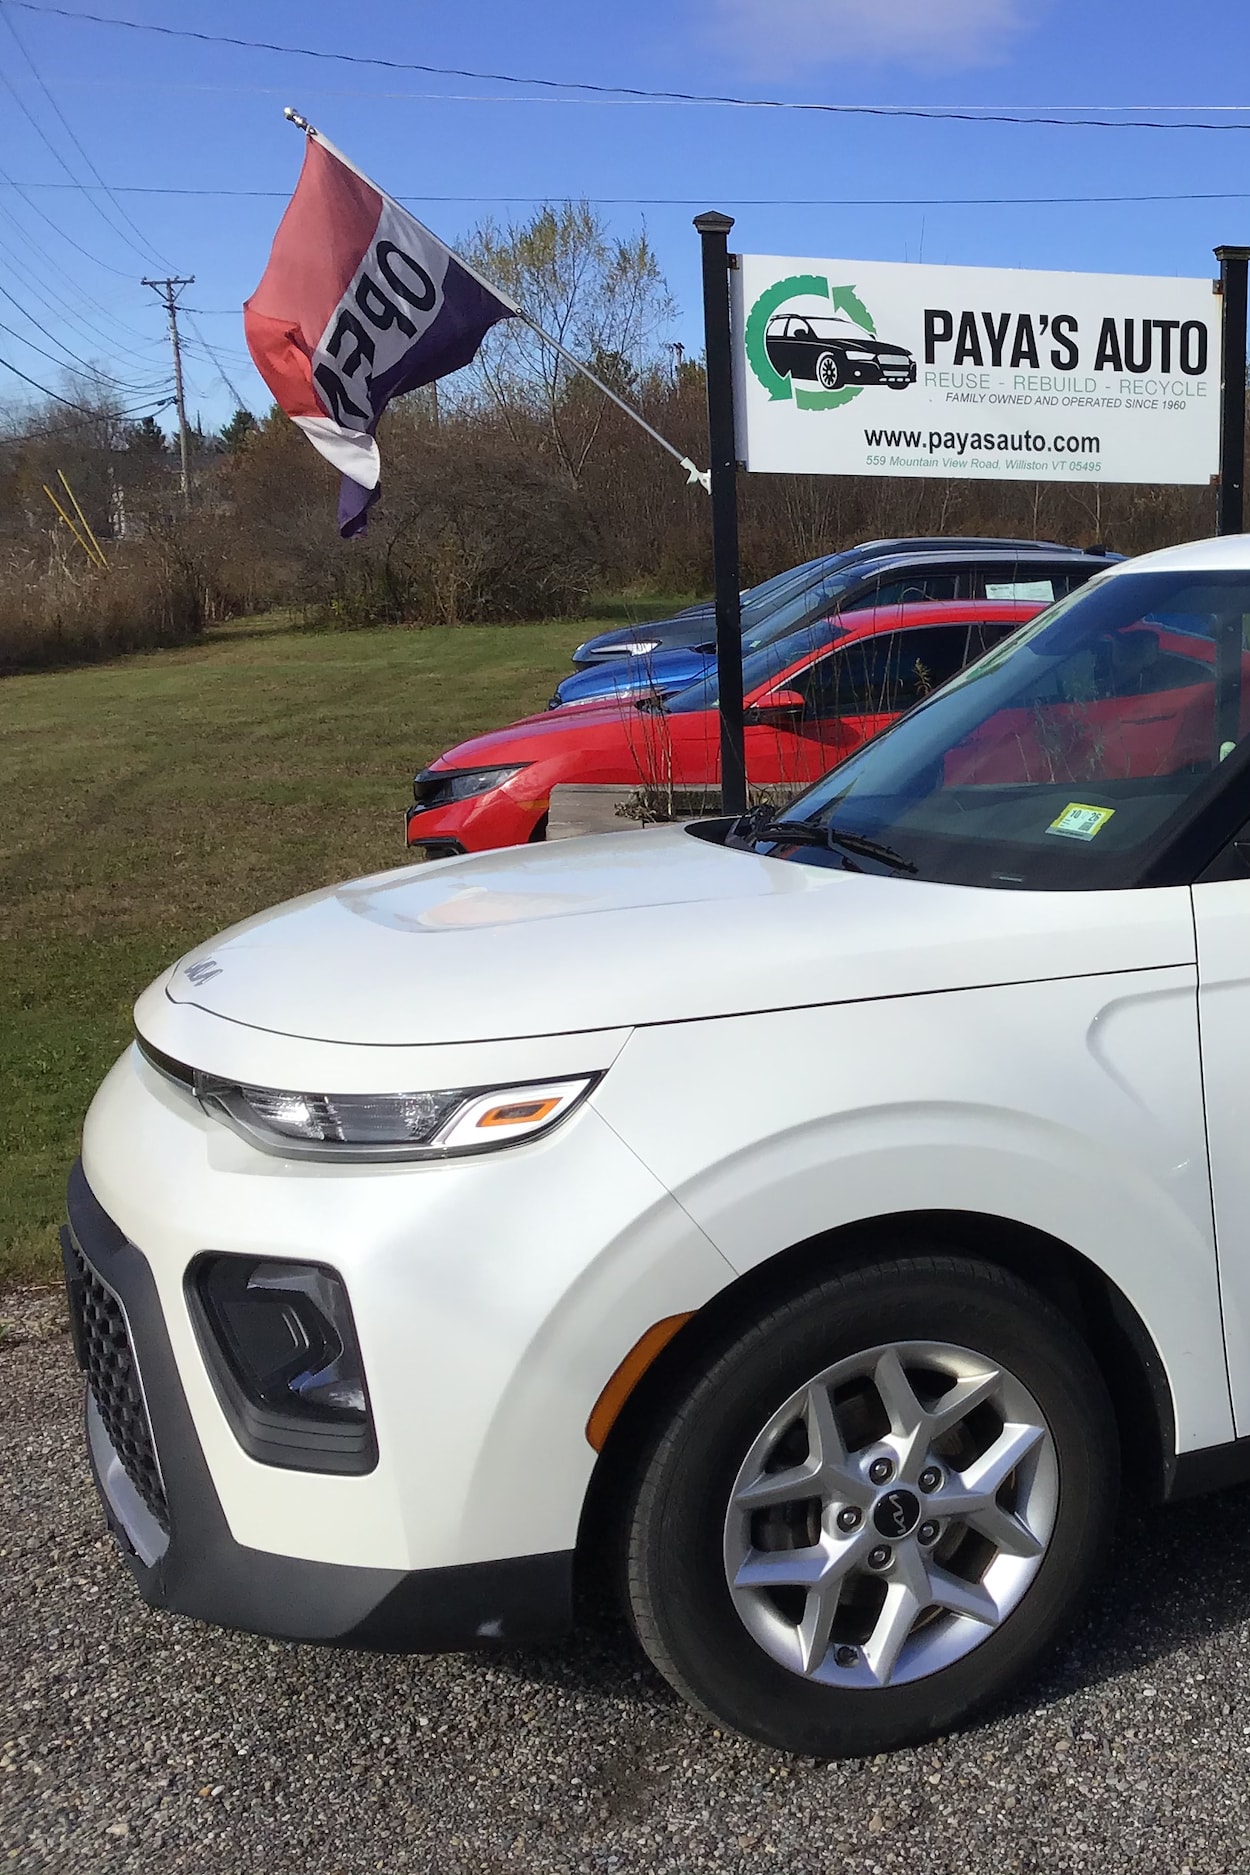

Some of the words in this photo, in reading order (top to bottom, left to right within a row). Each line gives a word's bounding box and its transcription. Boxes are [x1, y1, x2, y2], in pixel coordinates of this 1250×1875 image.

[923, 309, 1079, 371] PAYA'S
[1093, 317, 1208, 376] AUTO
[924, 371, 991, 389] REUSE
[1013, 375, 1097, 393] REBUILD
[1119, 379, 1207, 397] RECYCLE
[945, 392, 987, 404] FAMILY
[988, 394, 1032, 405] OWNED
[1034, 396, 1059, 406] AND
[1062, 396, 1122, 408] OPERATED
[1125, 398, 1159, 410] SINCE
[1162, 400, 1186, 410] 1960
[864, 429, 1100, 455] www.payasauto.com
[865, 455, 886, 466] 559
[889, 456, 939, 468] Mountain
[942, 457, 968, 468] View
[970, 458, 1001, 471] Road,
[1005, 459, 1048, 471] Williston
[1051, 460, 1067, 471] VT
[1069, 461, 1102, 472] 05495
